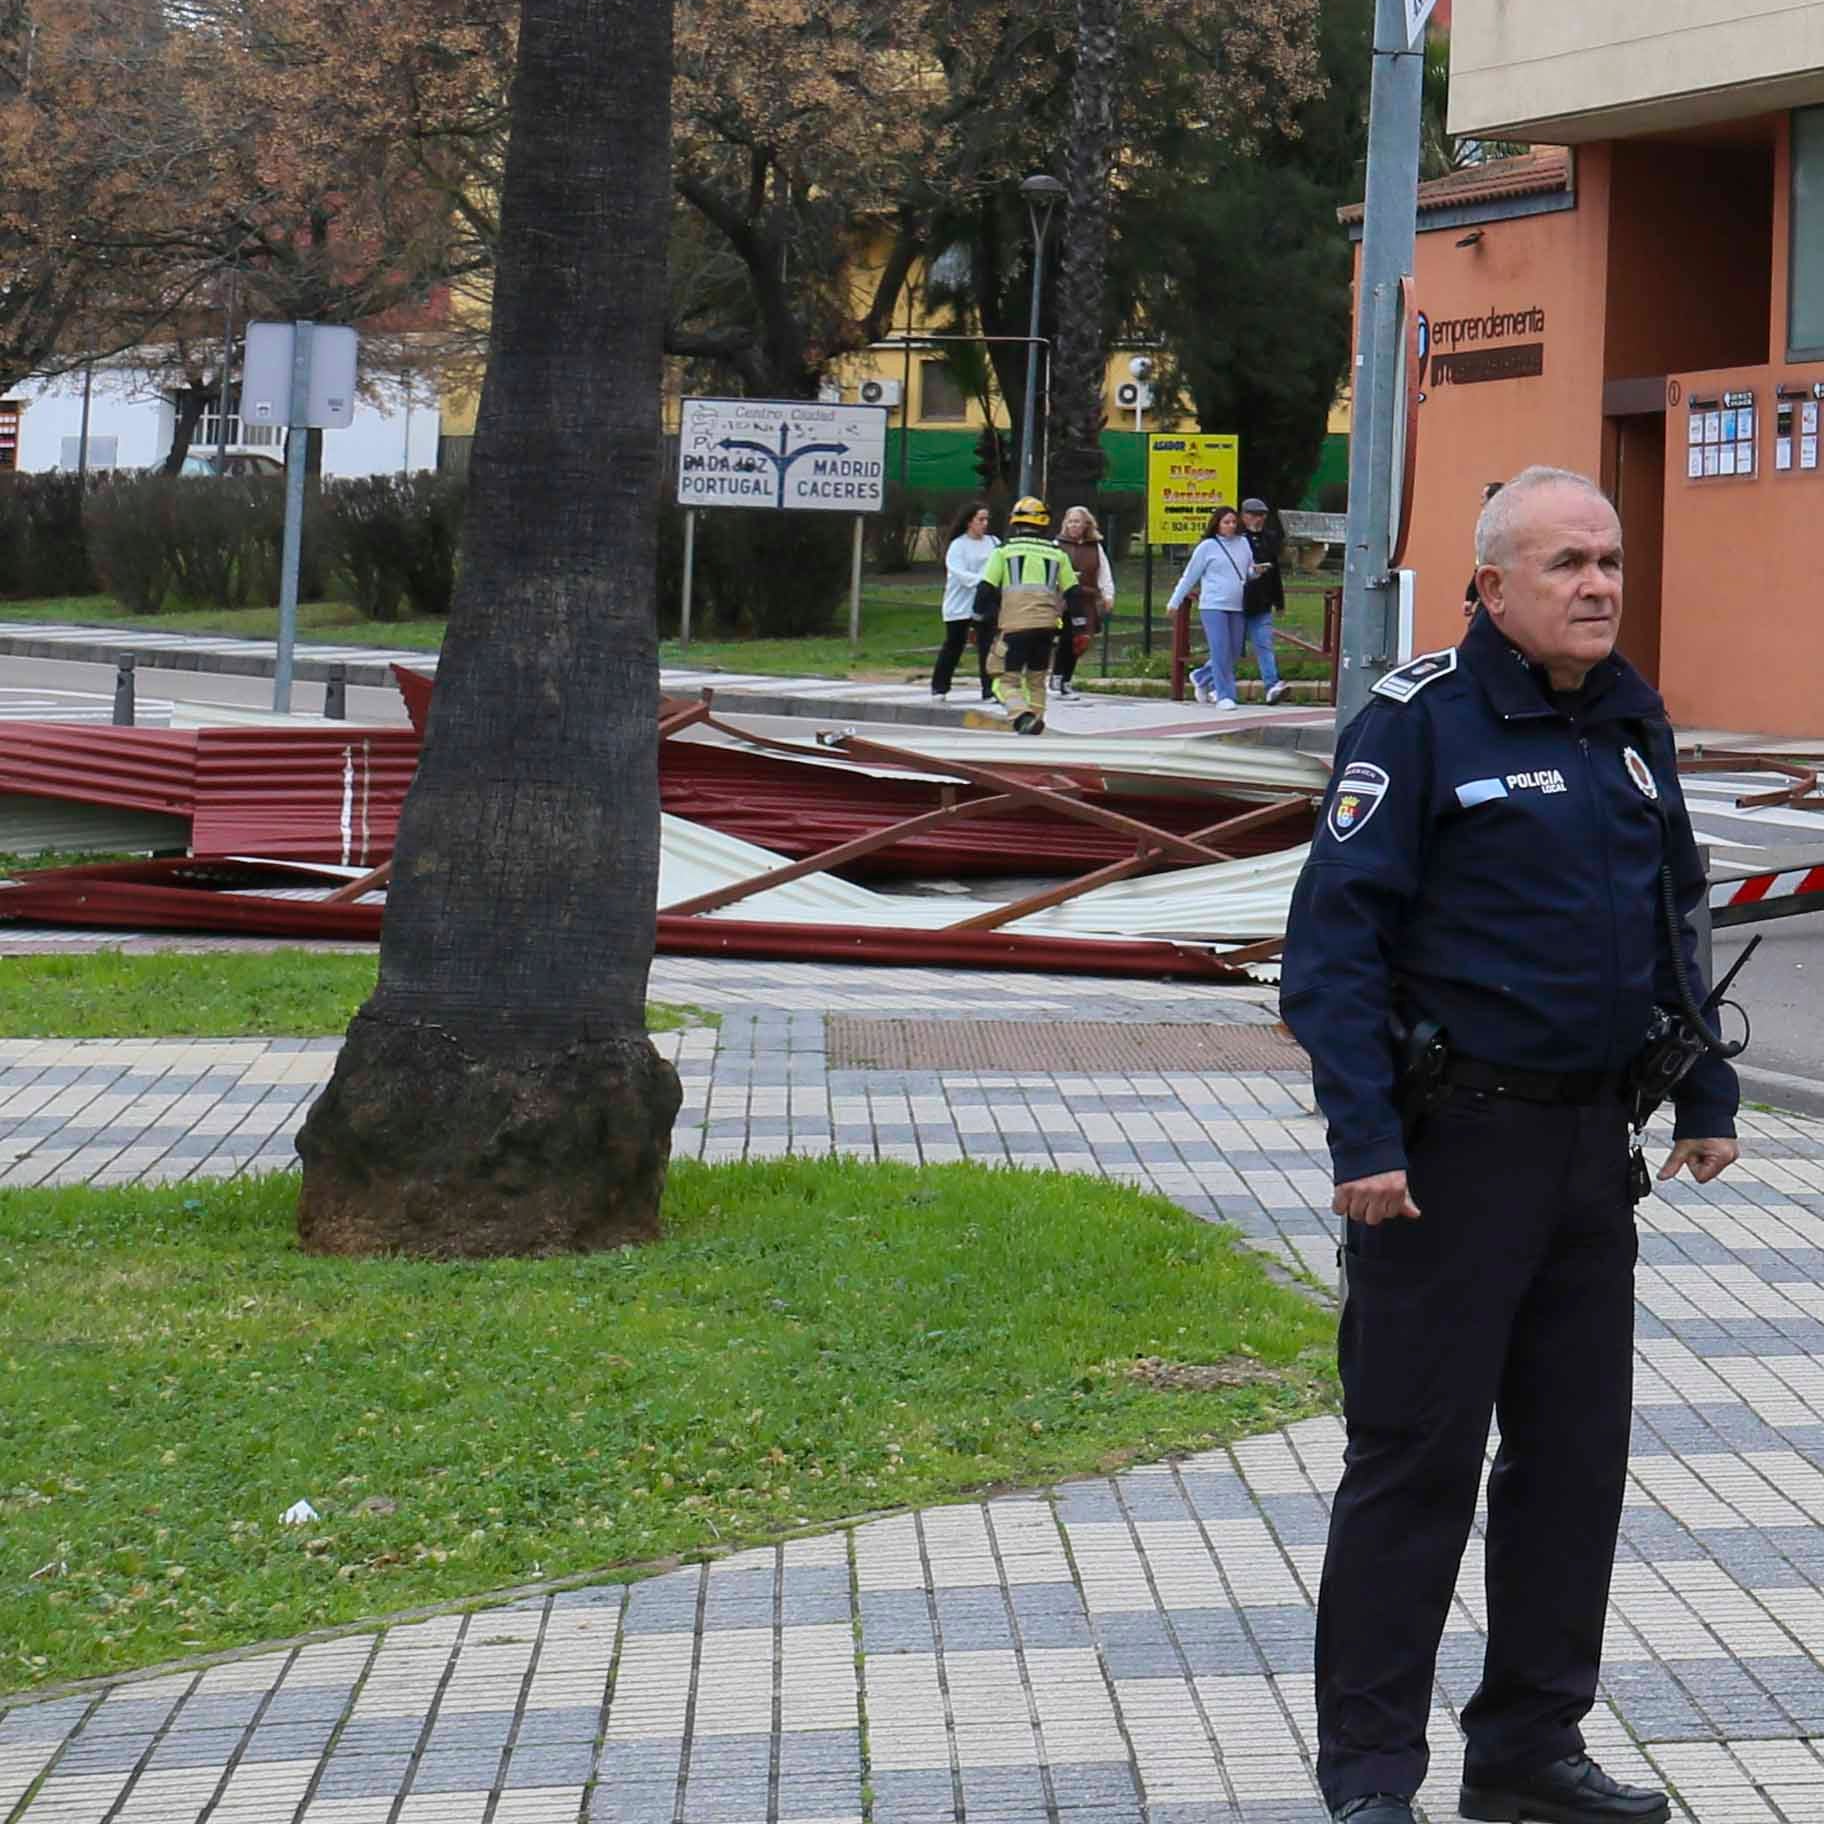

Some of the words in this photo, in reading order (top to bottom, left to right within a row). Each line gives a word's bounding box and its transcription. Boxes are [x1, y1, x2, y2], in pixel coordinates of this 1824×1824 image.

[736, 405, 784, 421] Centro
[814, 459, 881, 478] MADRID
[682, 476, 773, 496] PORTUGAL
[797, 480, 881, 499] CACERES
[1505, 769, 1564, 789] POLICIA
[1541, 783, 1568, 794] LOCAL
